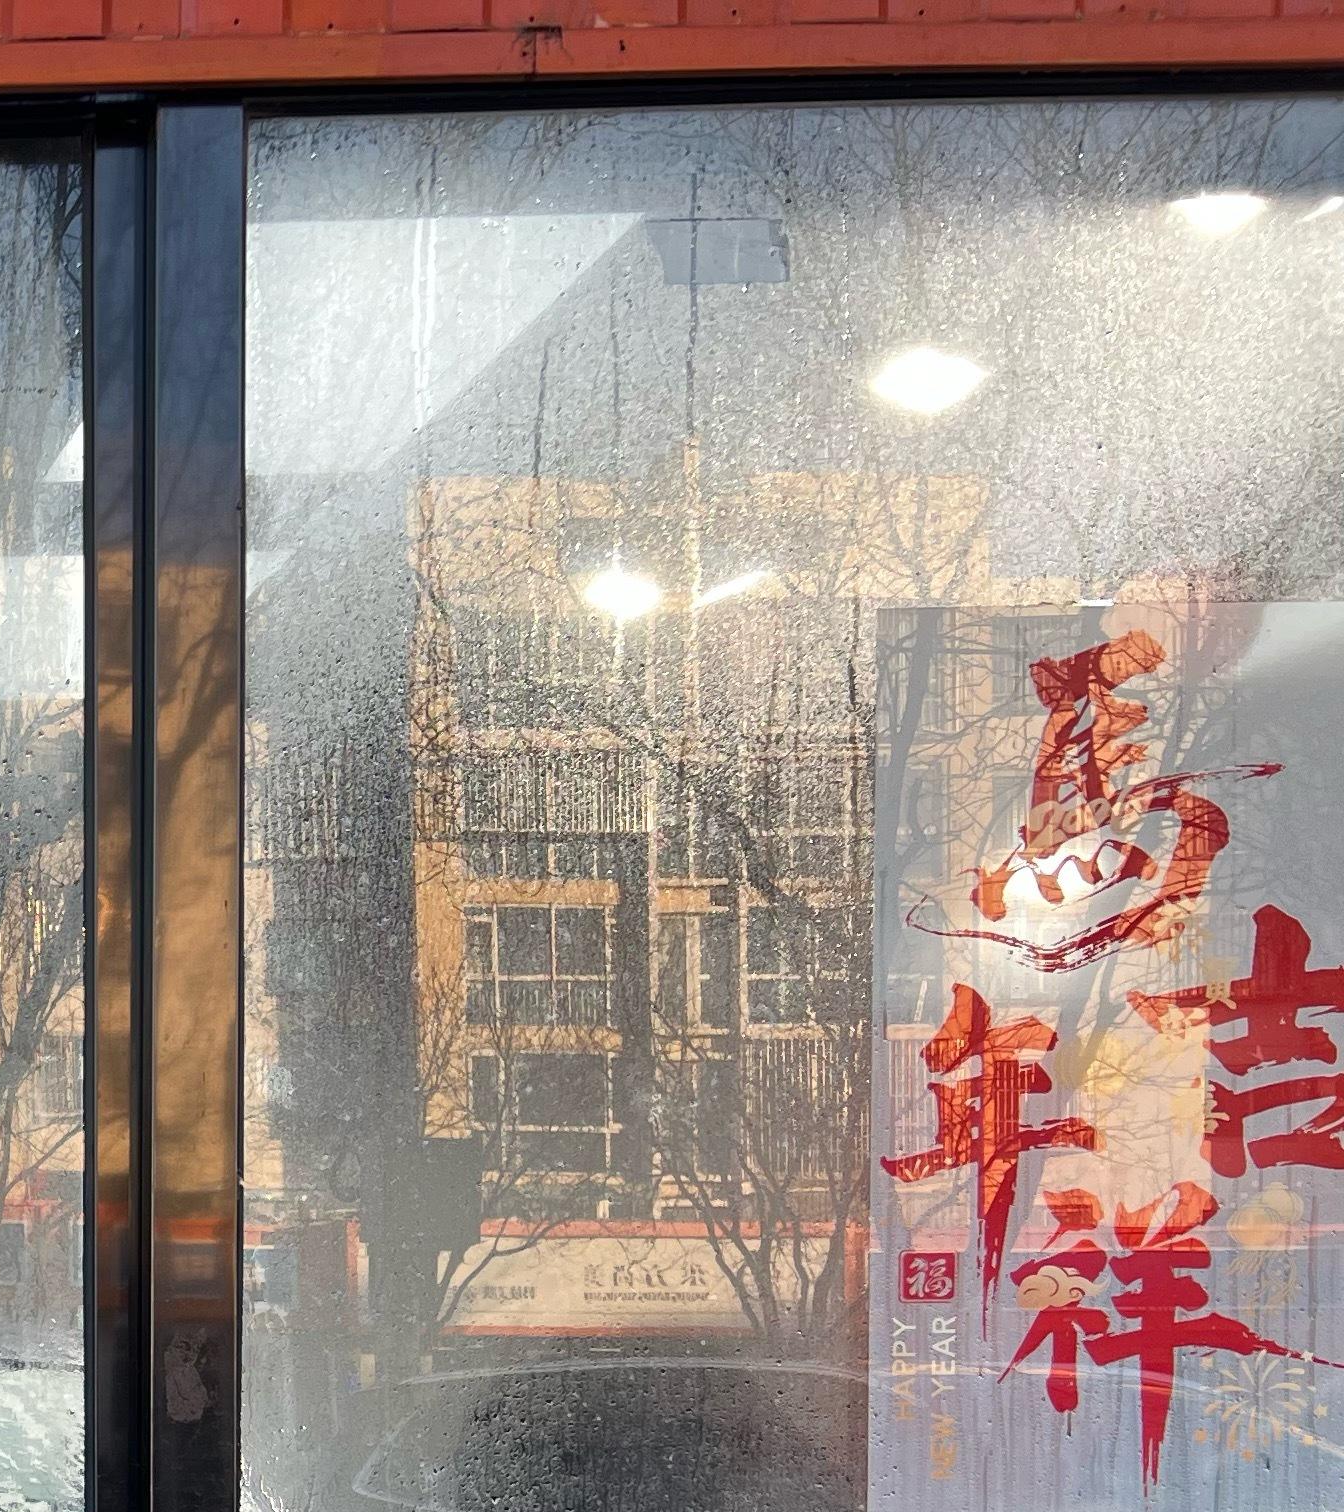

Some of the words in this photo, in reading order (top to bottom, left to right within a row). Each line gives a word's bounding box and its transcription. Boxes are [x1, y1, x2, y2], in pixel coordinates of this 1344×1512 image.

[908, 1257, 953, 1297] 福
[892, 1317, 917, 1421] HAPPY
[931, 1316, 957, 1398] YEAR
[931, 1412, 957, 1480] NEW
